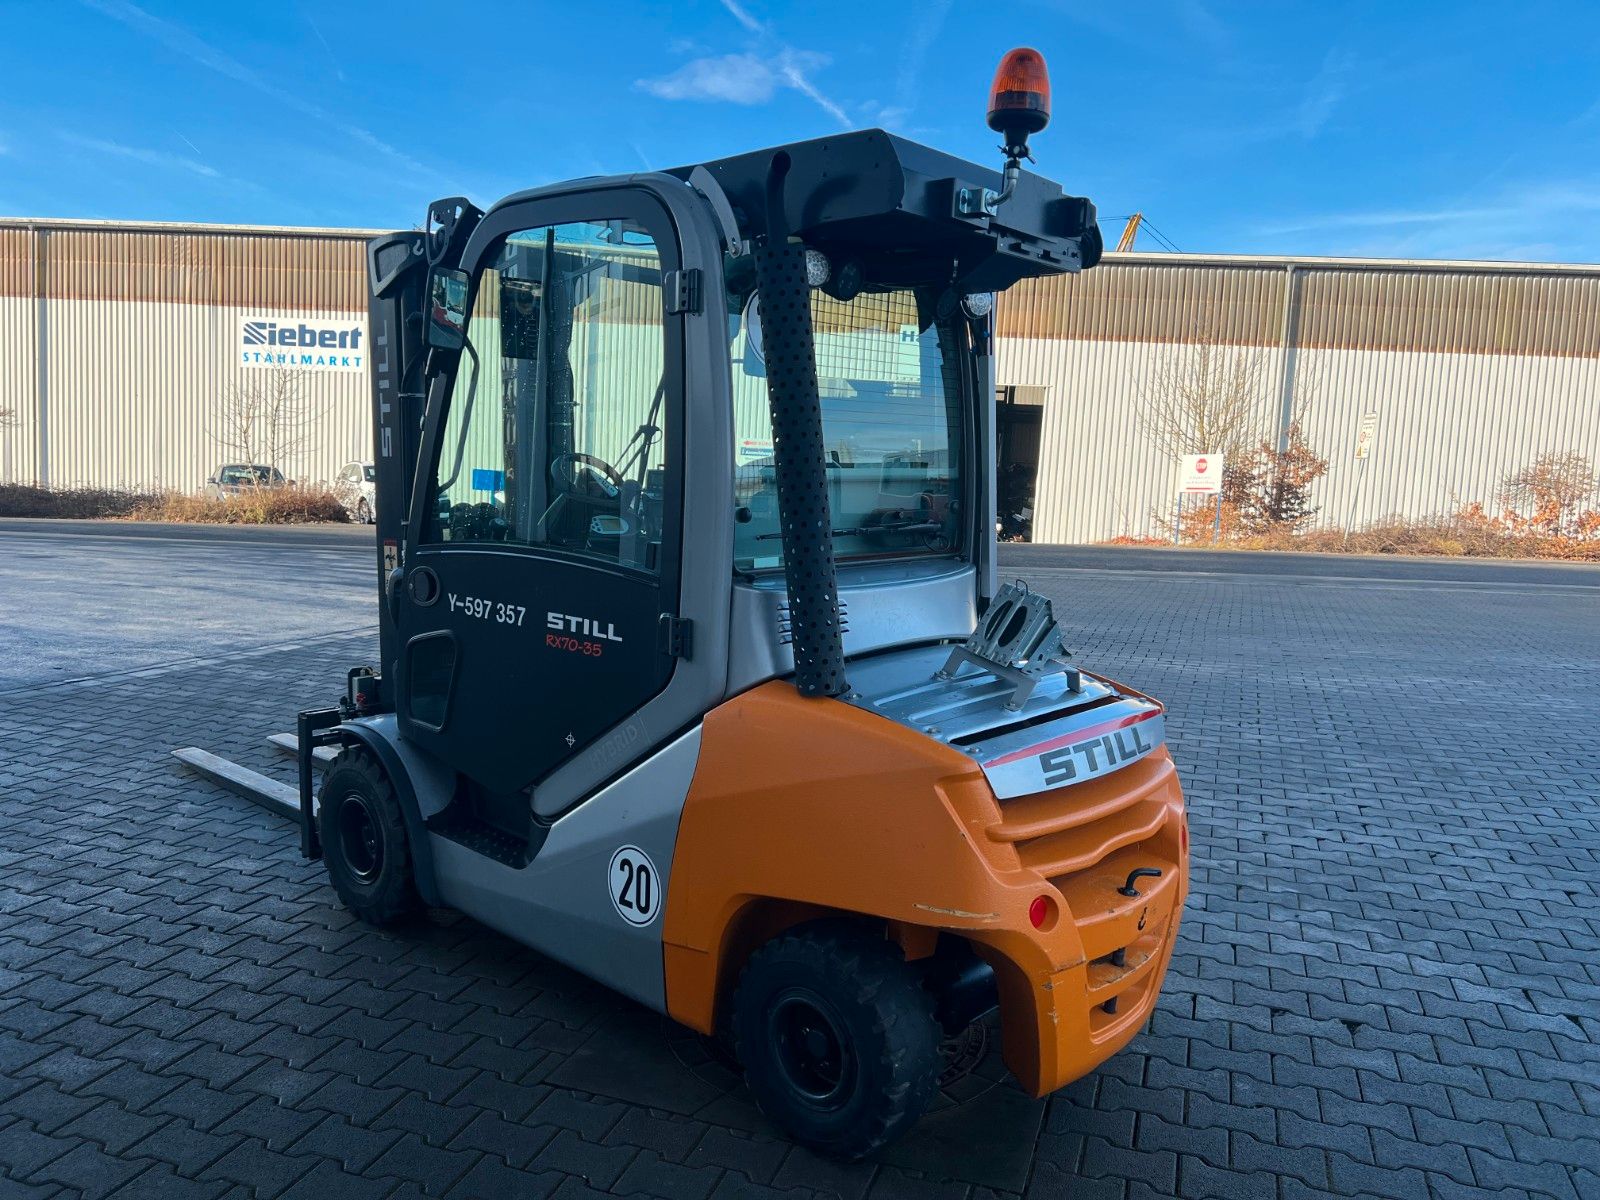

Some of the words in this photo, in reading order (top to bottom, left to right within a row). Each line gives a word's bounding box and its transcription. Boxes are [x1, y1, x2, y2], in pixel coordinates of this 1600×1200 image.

[243, 322, 362, 349] Siebert
[243, 352, 362, 367] STAHLMARKT
[377, 320, 392, 457] STILL
[448, 593, 492, 619] Y-597
[496, 603, 526, 626] 357
[547, 612, 623, 642] STILL
[545, 634, 602, 656] RX70-35
[1039, 727, 1151, 786] STILL
[619, 858, 650, 914] 20
